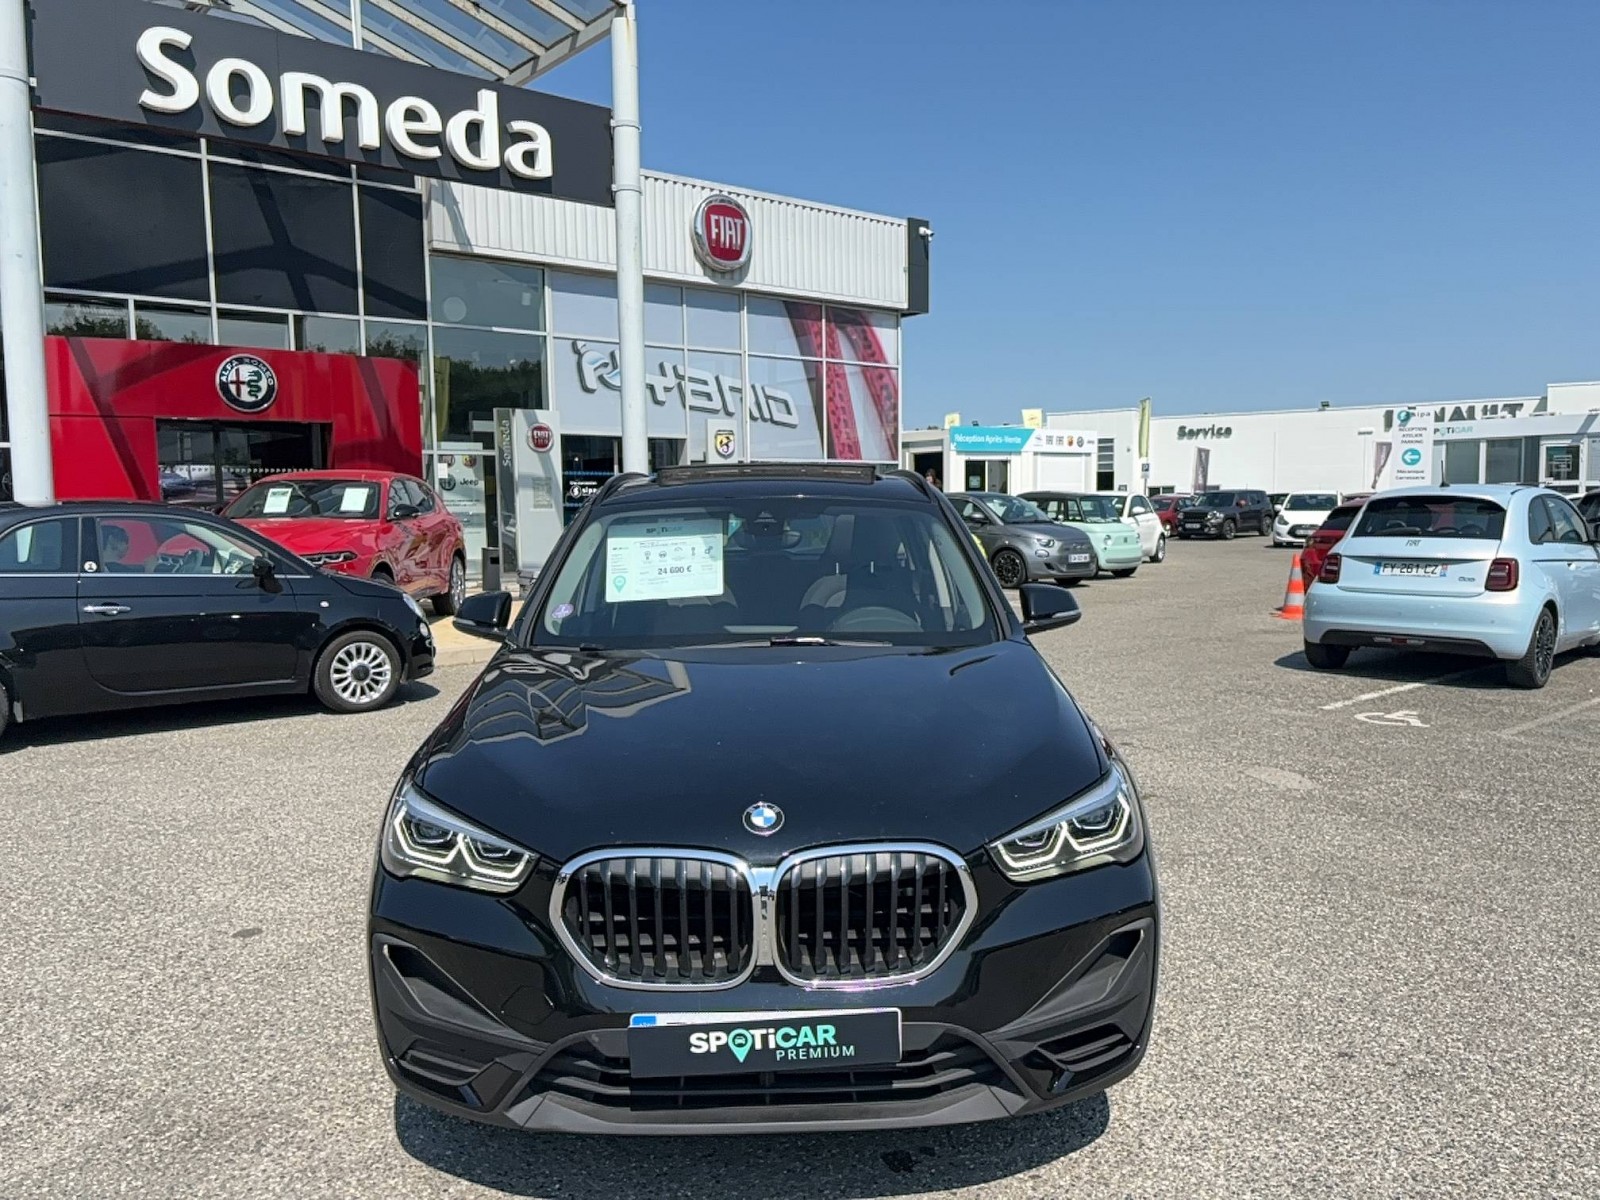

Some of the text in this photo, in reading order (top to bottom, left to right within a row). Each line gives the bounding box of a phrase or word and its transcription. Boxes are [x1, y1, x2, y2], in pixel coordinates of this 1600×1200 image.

[136, 26, 553, 180] Someda
[710, 214, 743, 250] FIAT
[220, 358, 274, 386] ALFA ROMEO
[954, 434, 984, 445] Réception
[1176, 424, 1232, 440] Service
[501, 419, 511, 467] Someda
[460, 478, 479, 486] Jeep
[1382, 563, 1439, 575] FY-261-CZ
[776, 1045, 855, 1061] PREMIUM
